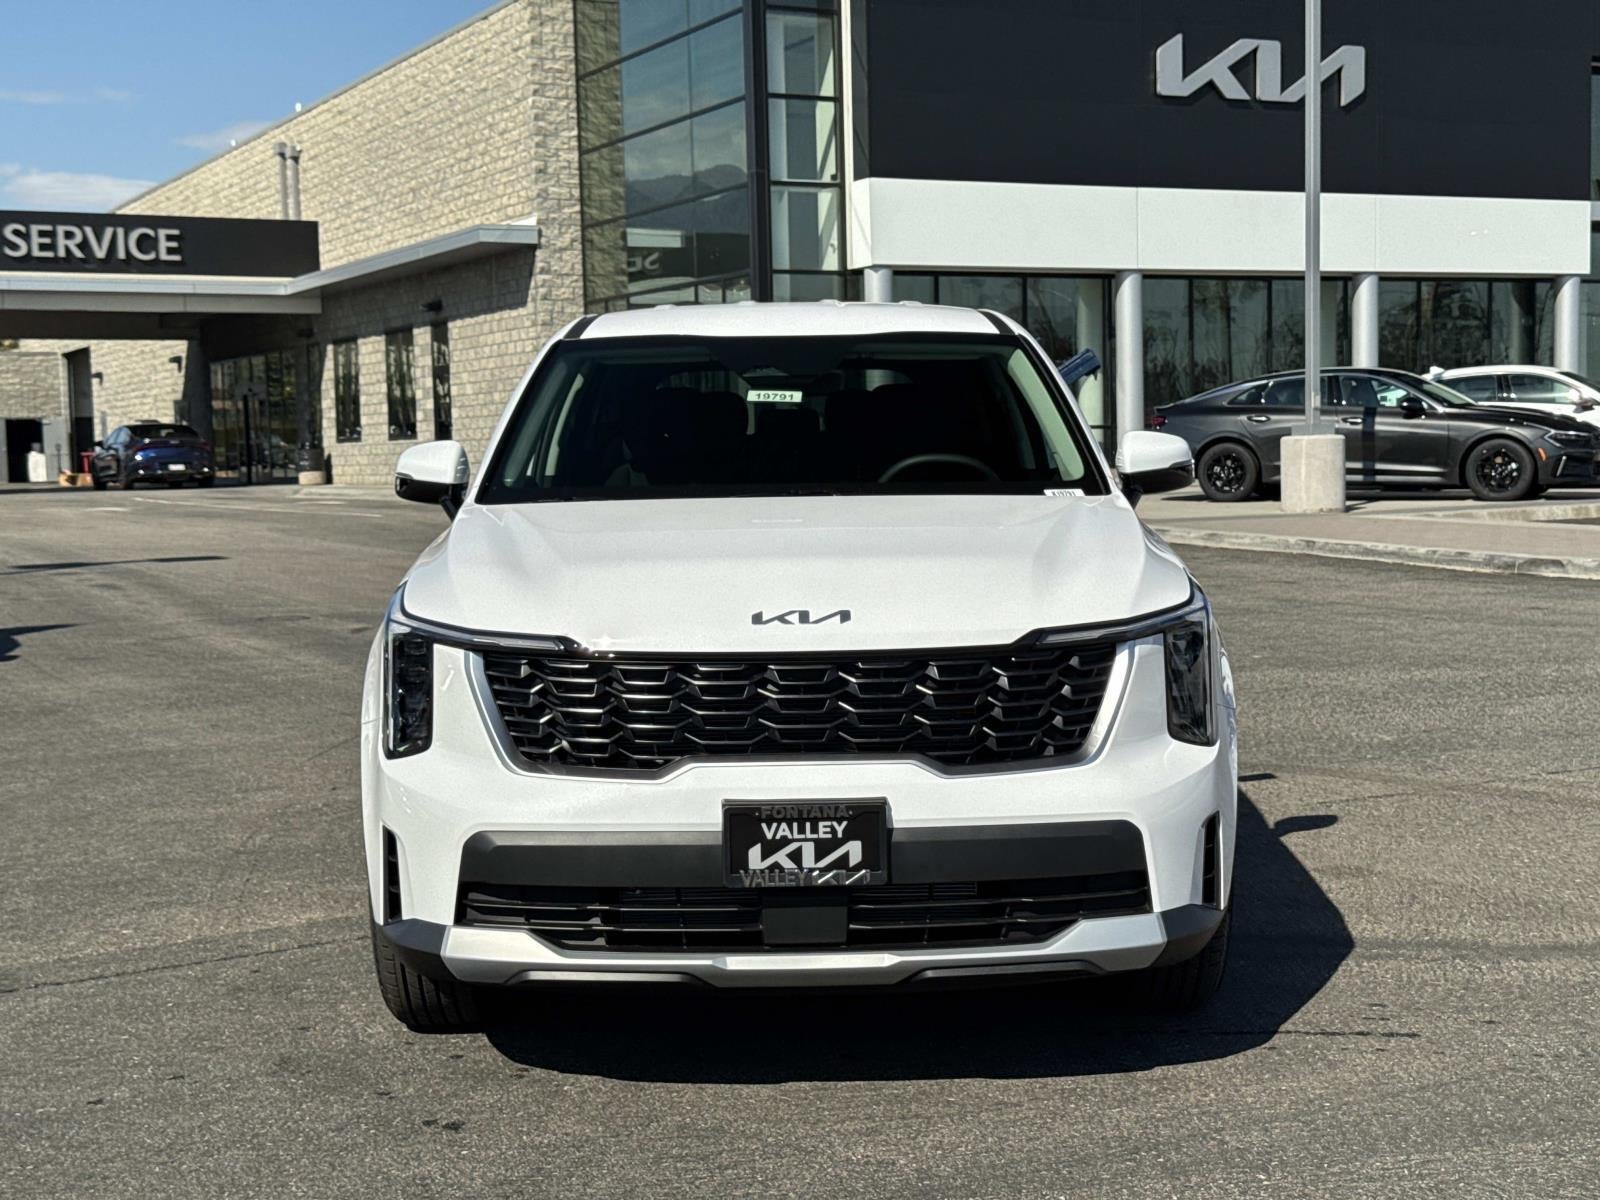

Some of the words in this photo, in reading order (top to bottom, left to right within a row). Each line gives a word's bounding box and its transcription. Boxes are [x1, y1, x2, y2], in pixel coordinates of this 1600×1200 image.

[1156, 33, 1366, 107] KIA
[2, 222, 183, 262] SERVICE
[755, 392, 794, 401] 19791
[751, 609, 851, 625] KIA
[760, 804, 850, 819] FONTANA
[760, 820, 849, 840] VALLEY
[748, 840, 862, 870] KIA
[739, 869, 808, 888] VALLEY
